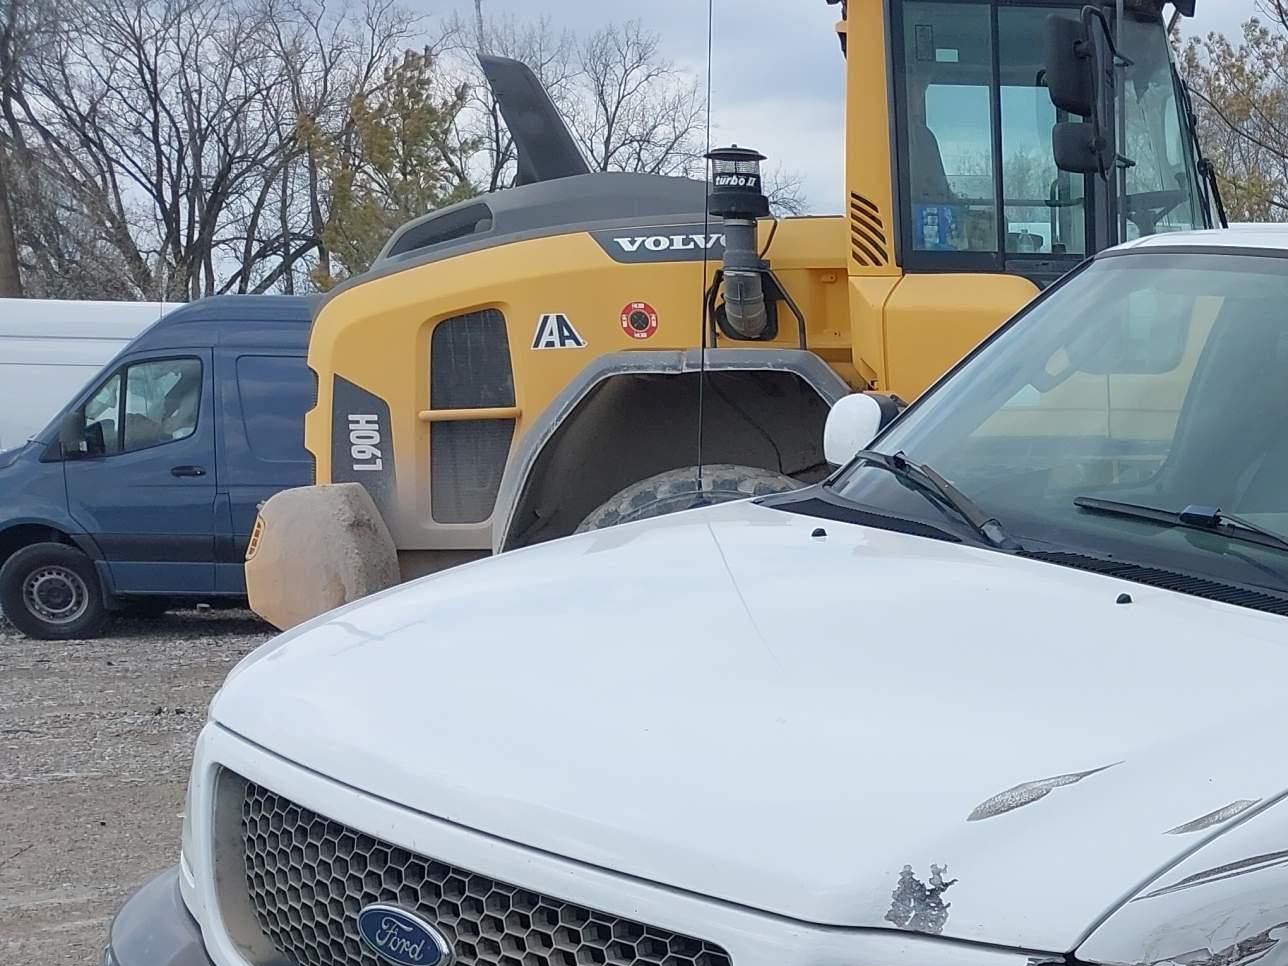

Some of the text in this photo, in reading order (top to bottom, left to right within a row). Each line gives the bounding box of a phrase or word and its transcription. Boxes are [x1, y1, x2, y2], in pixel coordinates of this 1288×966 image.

[715, 175, 746, 187] turbo
[347, 414, 383, 471] L90H
[375, 916, 426, 961] Ford
